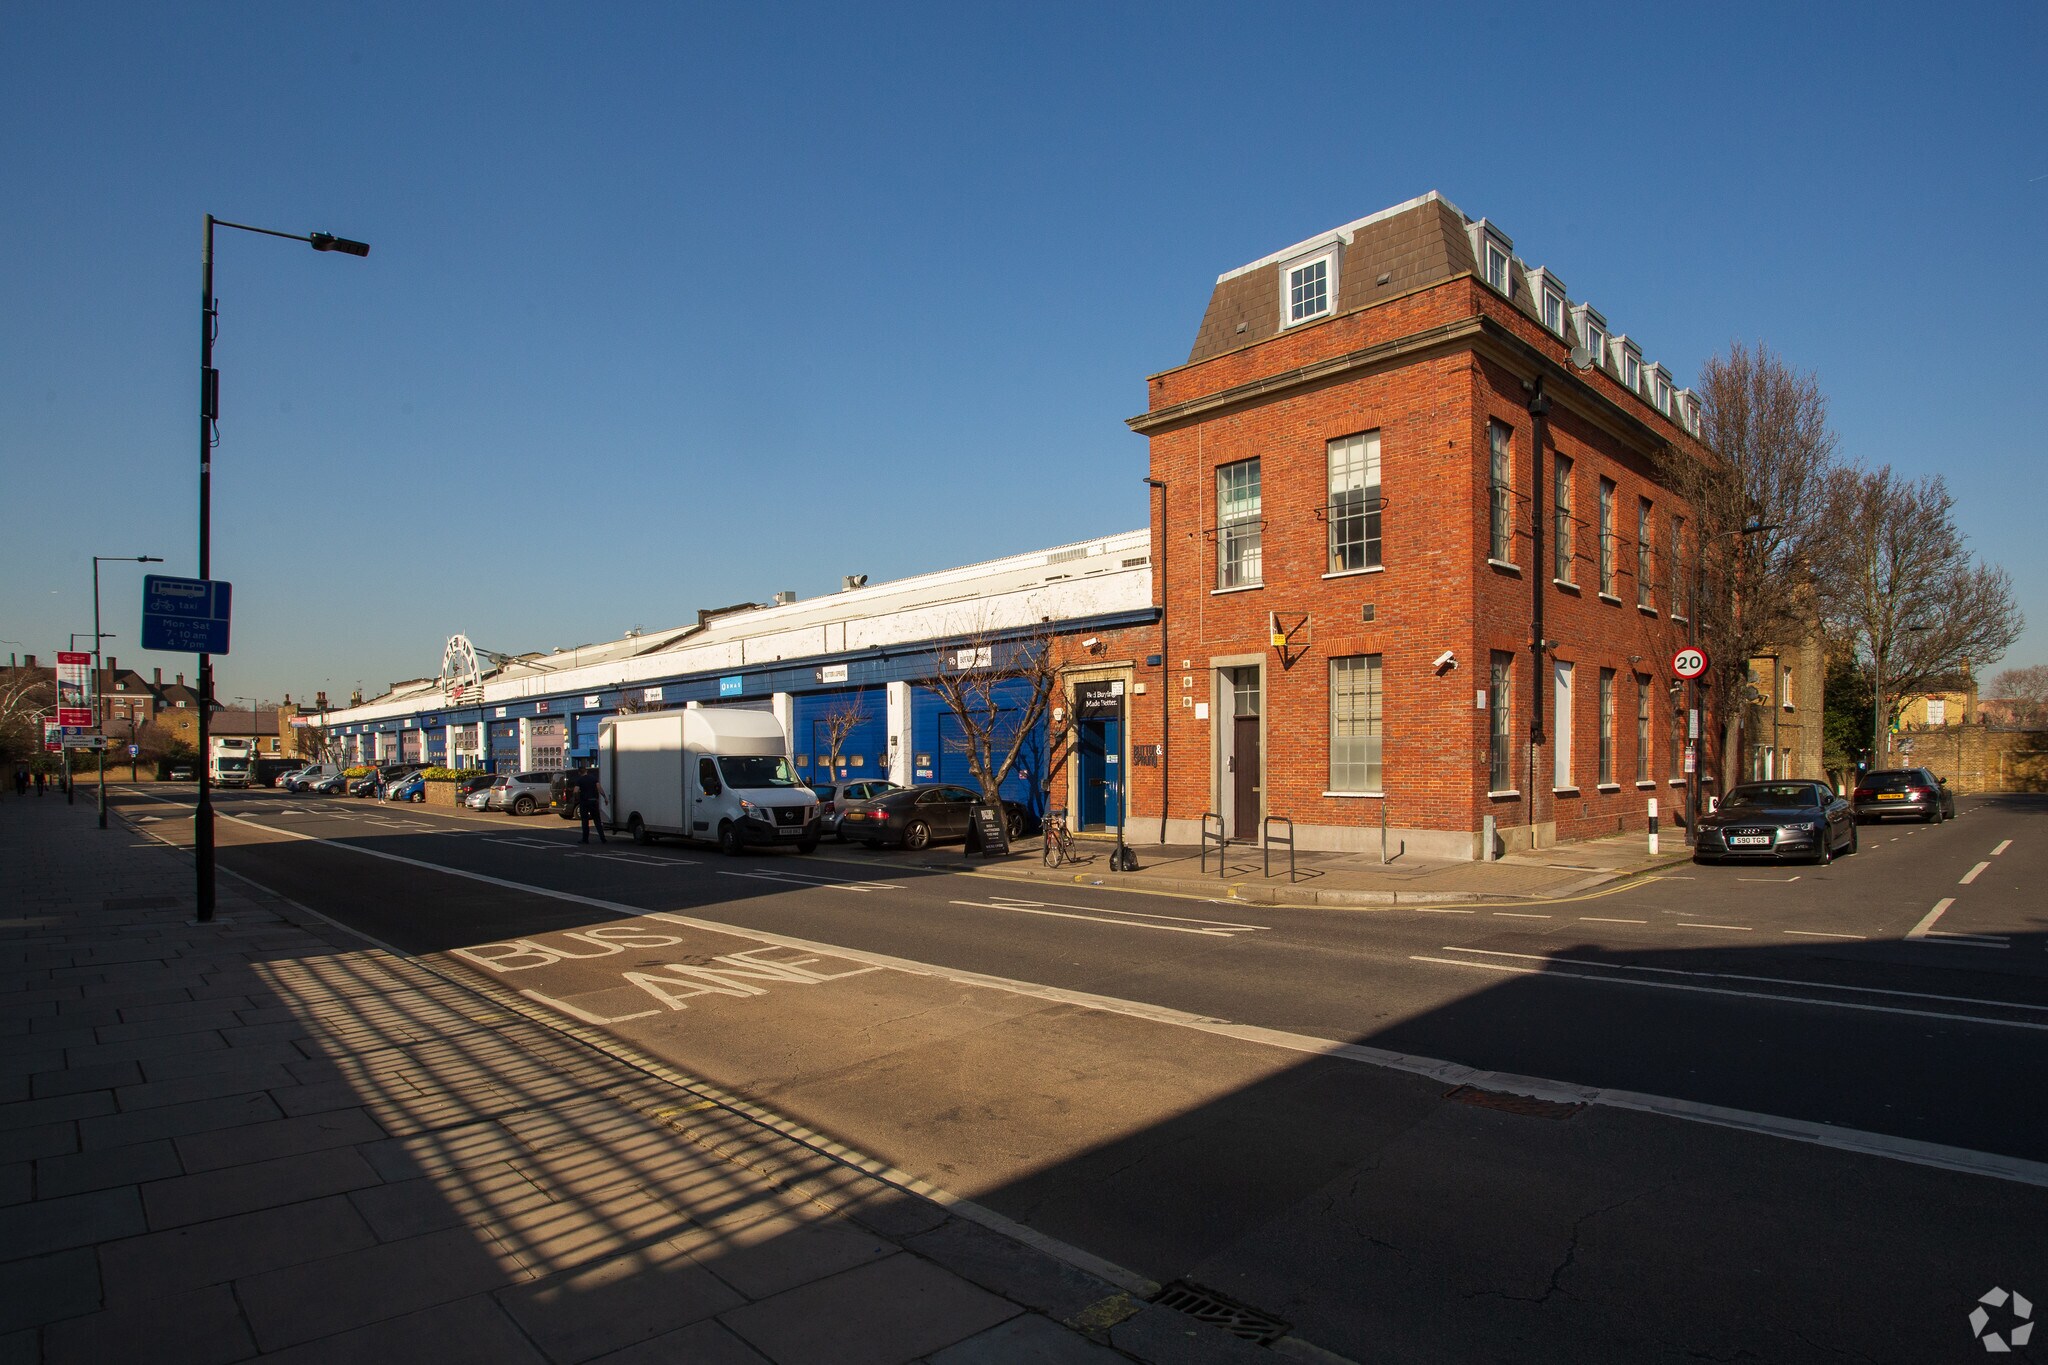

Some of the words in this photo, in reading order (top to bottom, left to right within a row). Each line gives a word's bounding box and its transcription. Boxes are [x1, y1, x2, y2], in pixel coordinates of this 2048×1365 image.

[178, 601, 198, 610] taxi
[162, 618, 185, 627] Mon
[192, 621, 210, 630] Sat
[1677, 655, 1701, 670] 20
[448, 926, 685, 973] BUS
[519, 945, 885, 1026] LANE
